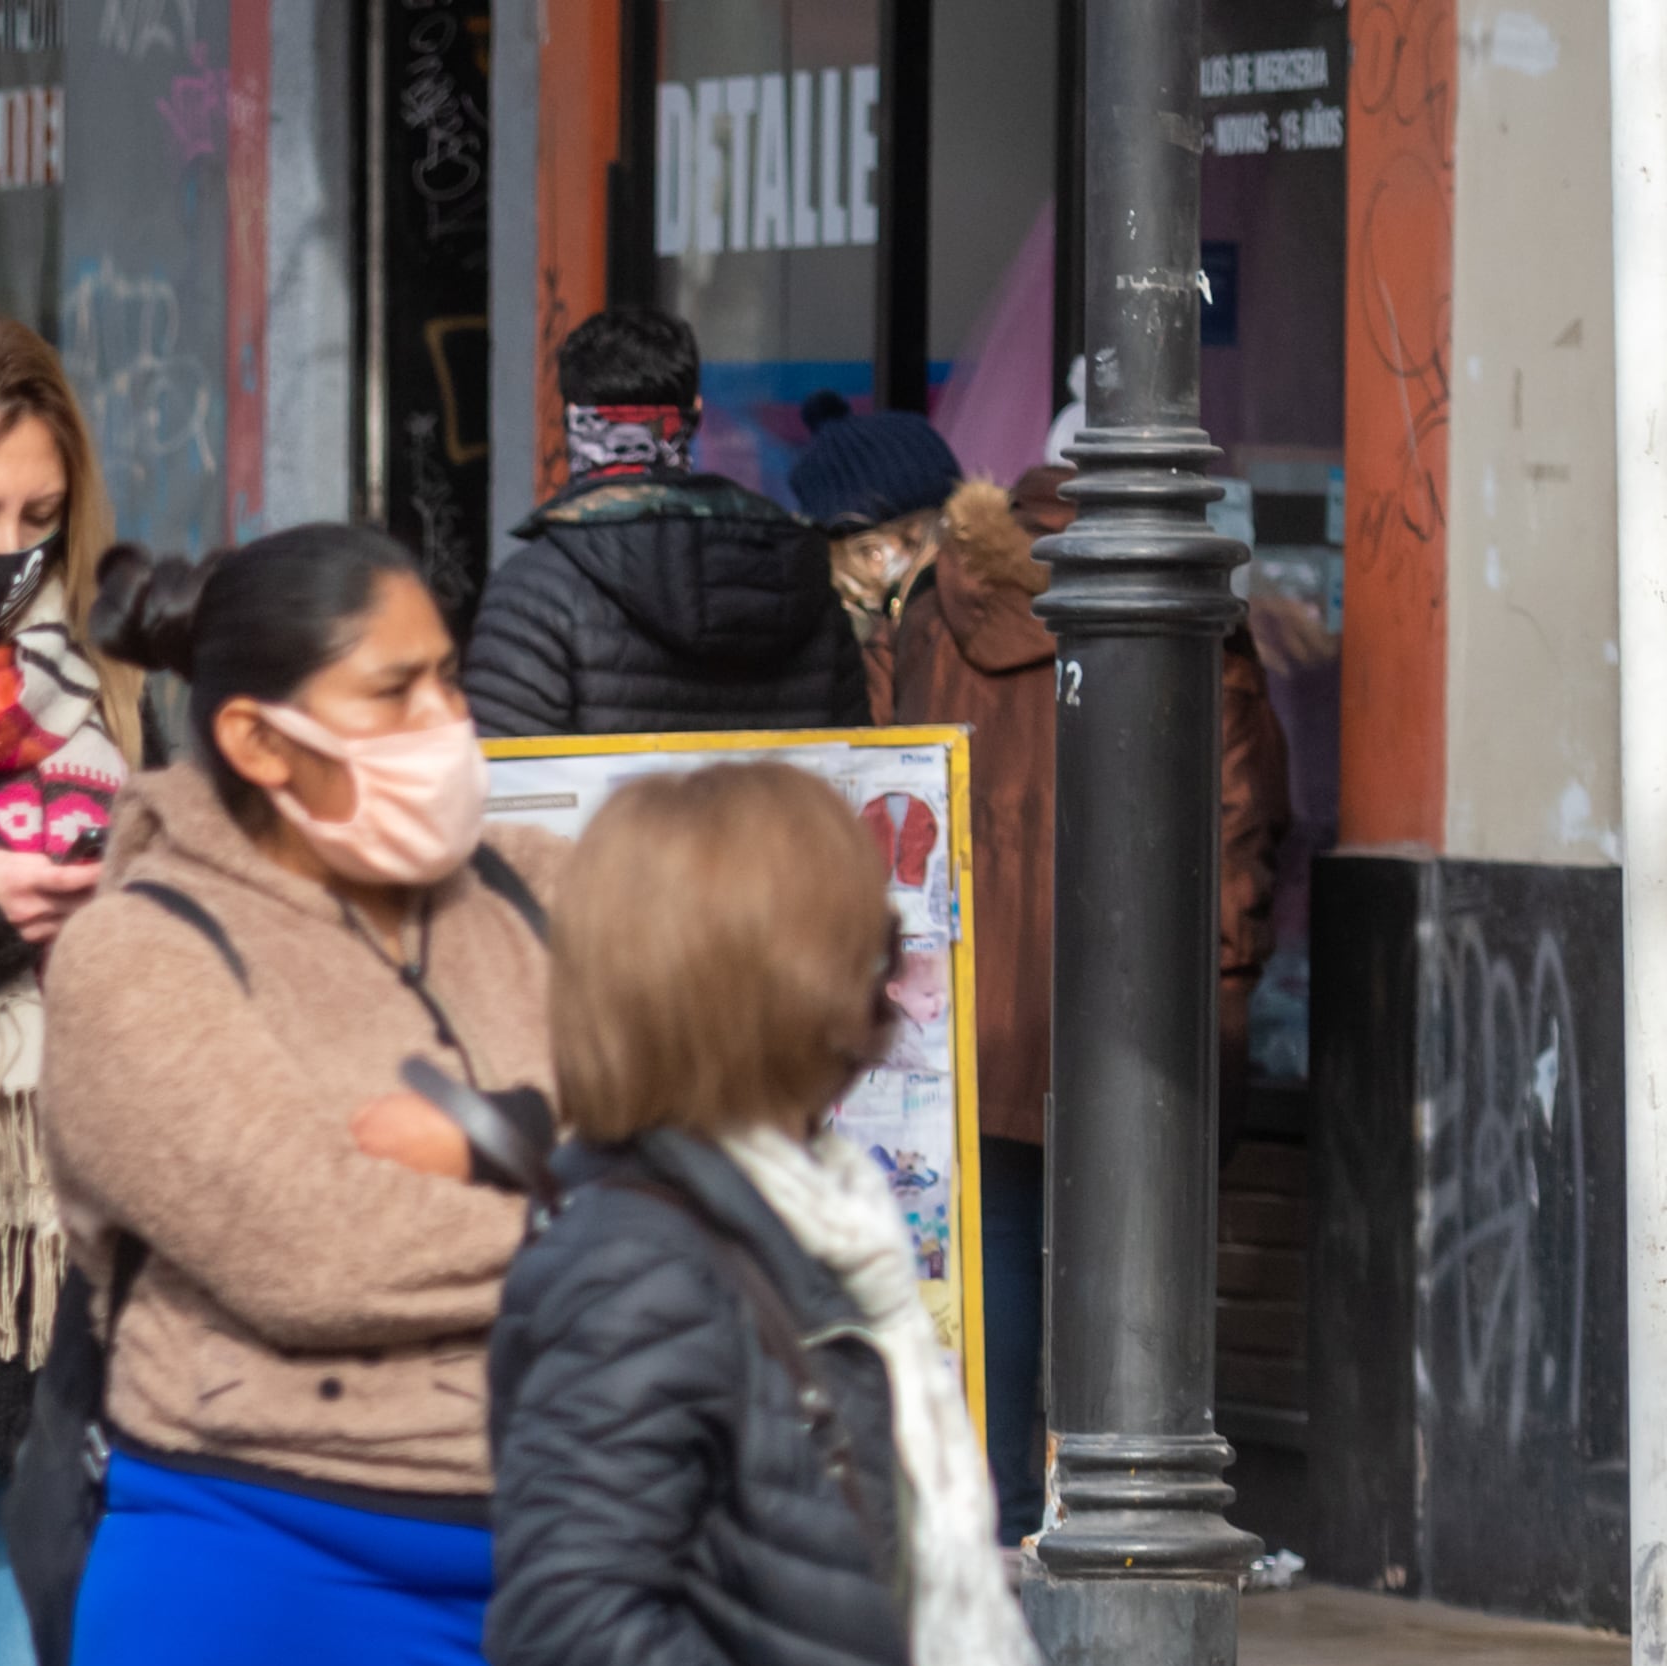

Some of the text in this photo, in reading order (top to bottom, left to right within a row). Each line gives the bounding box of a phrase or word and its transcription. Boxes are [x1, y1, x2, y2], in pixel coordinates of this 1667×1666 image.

[1231, 53, 1253, 95] DE
[1213, 111, 1269, 157] NOVIAS
[1302, 98, 1345, 149] AÑOS
[655, 65, 880, 257] DETALLE
